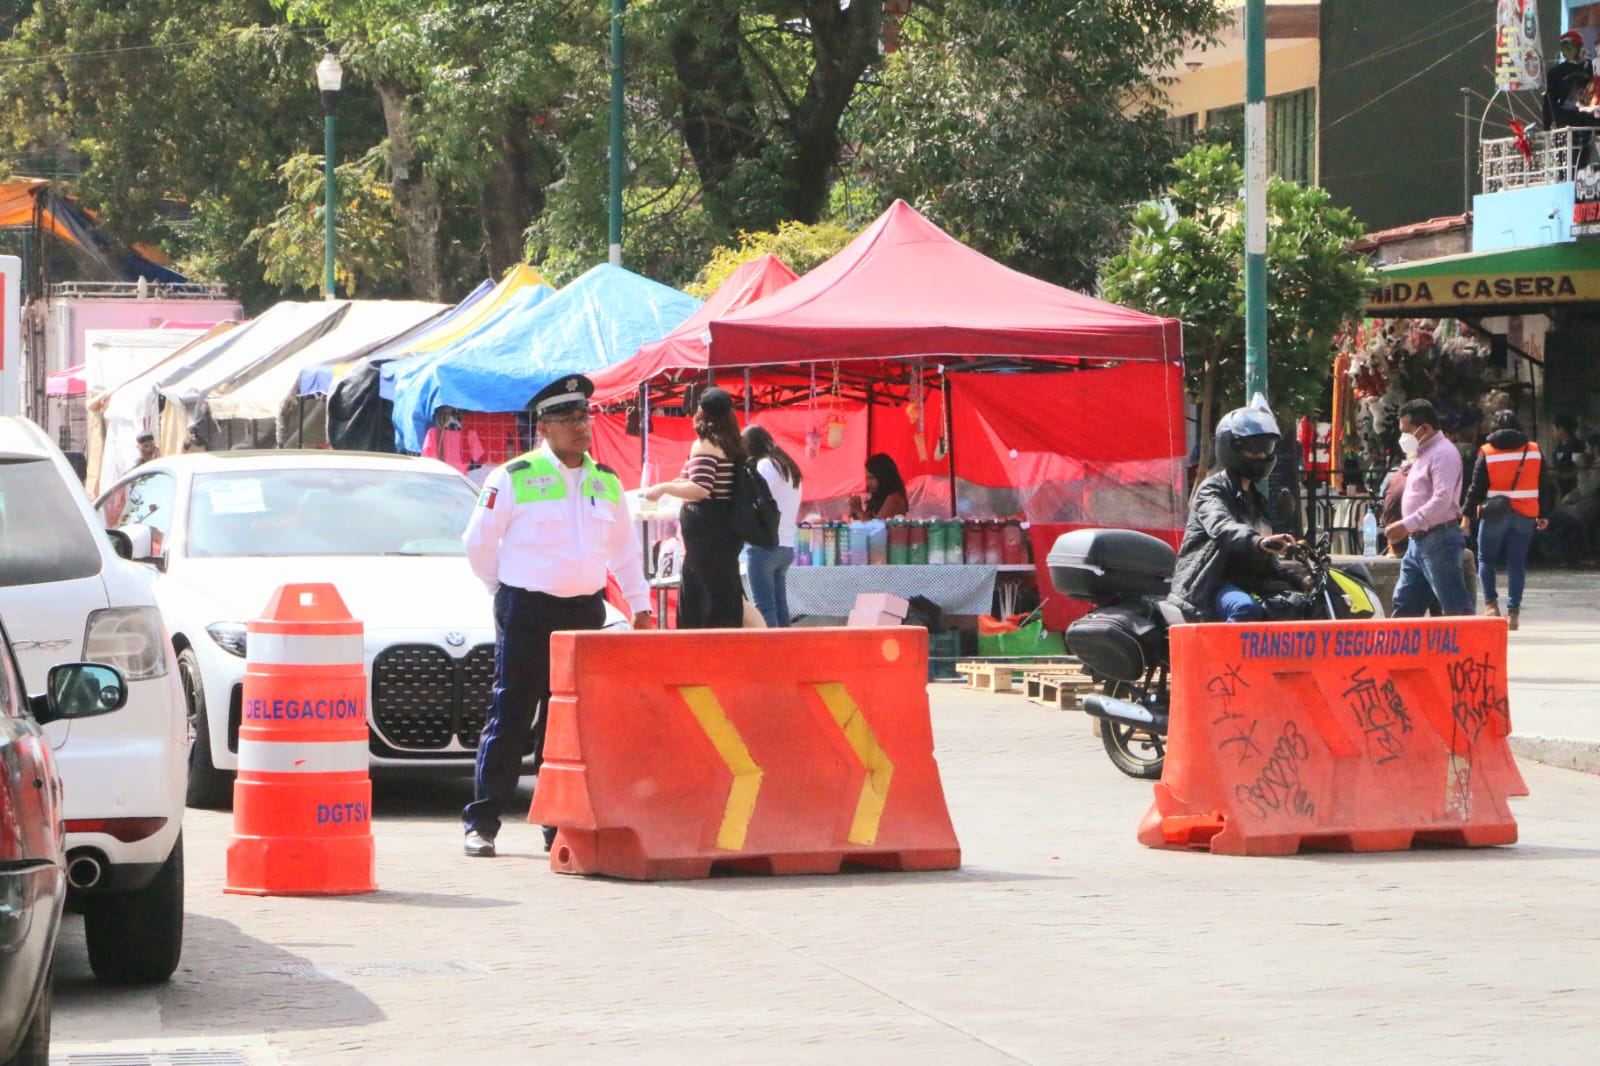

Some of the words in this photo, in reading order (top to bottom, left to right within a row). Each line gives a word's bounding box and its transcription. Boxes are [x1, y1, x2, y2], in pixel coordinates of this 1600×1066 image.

[1452, 275, 1577, 299] CASERA
[1321, 631, 1331, 657] Y
[1335, 630, 1422, 657] SEGURIDAD
[246, 694, 357, 719] DELEGACIÓN
